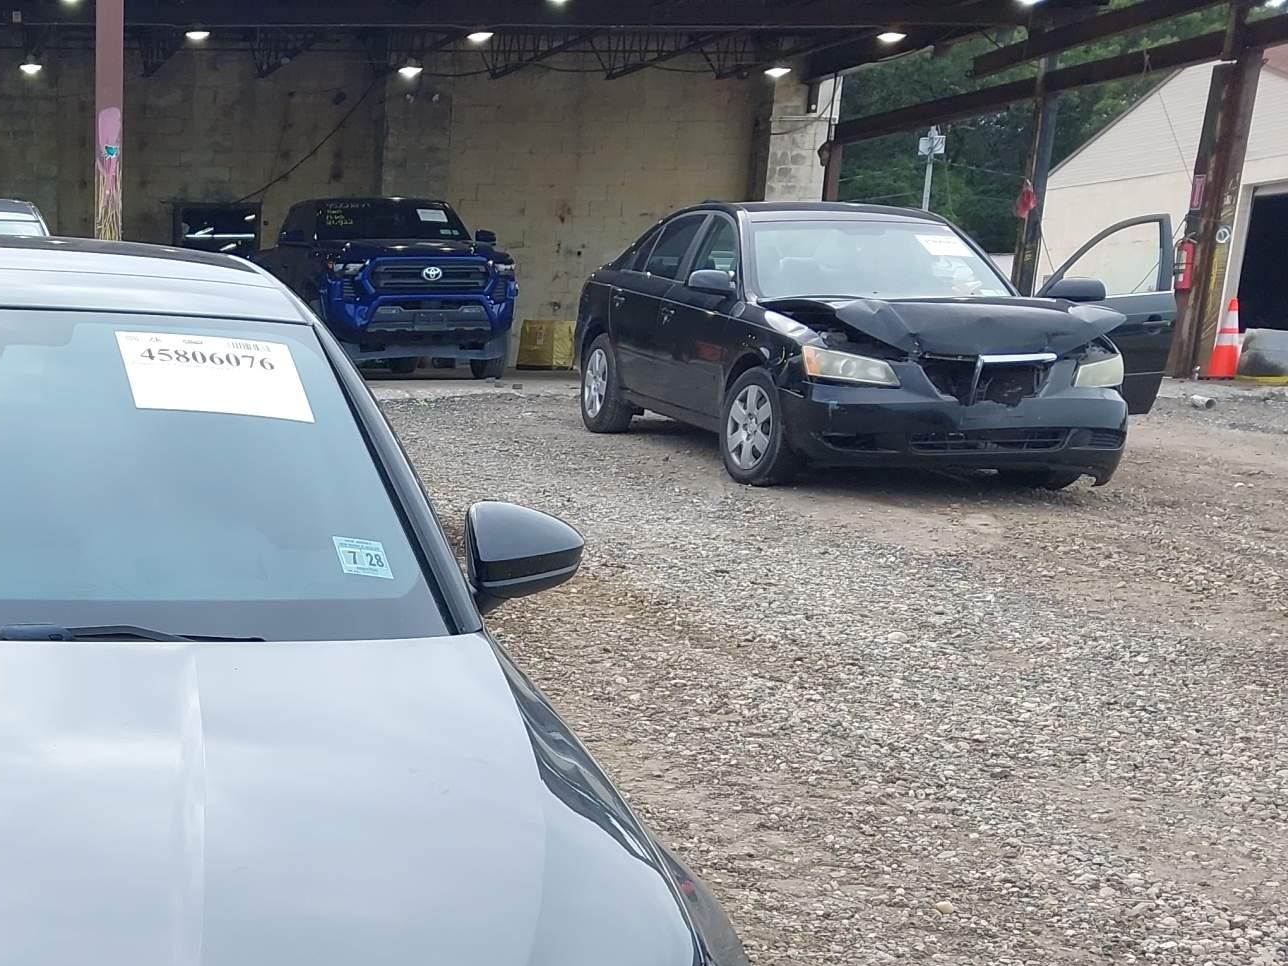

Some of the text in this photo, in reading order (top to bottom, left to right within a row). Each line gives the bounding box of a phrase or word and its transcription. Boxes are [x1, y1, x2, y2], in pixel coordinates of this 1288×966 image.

[139, 347, 275, 371] 45806076
[347, 550, 385, 568] 7 28
